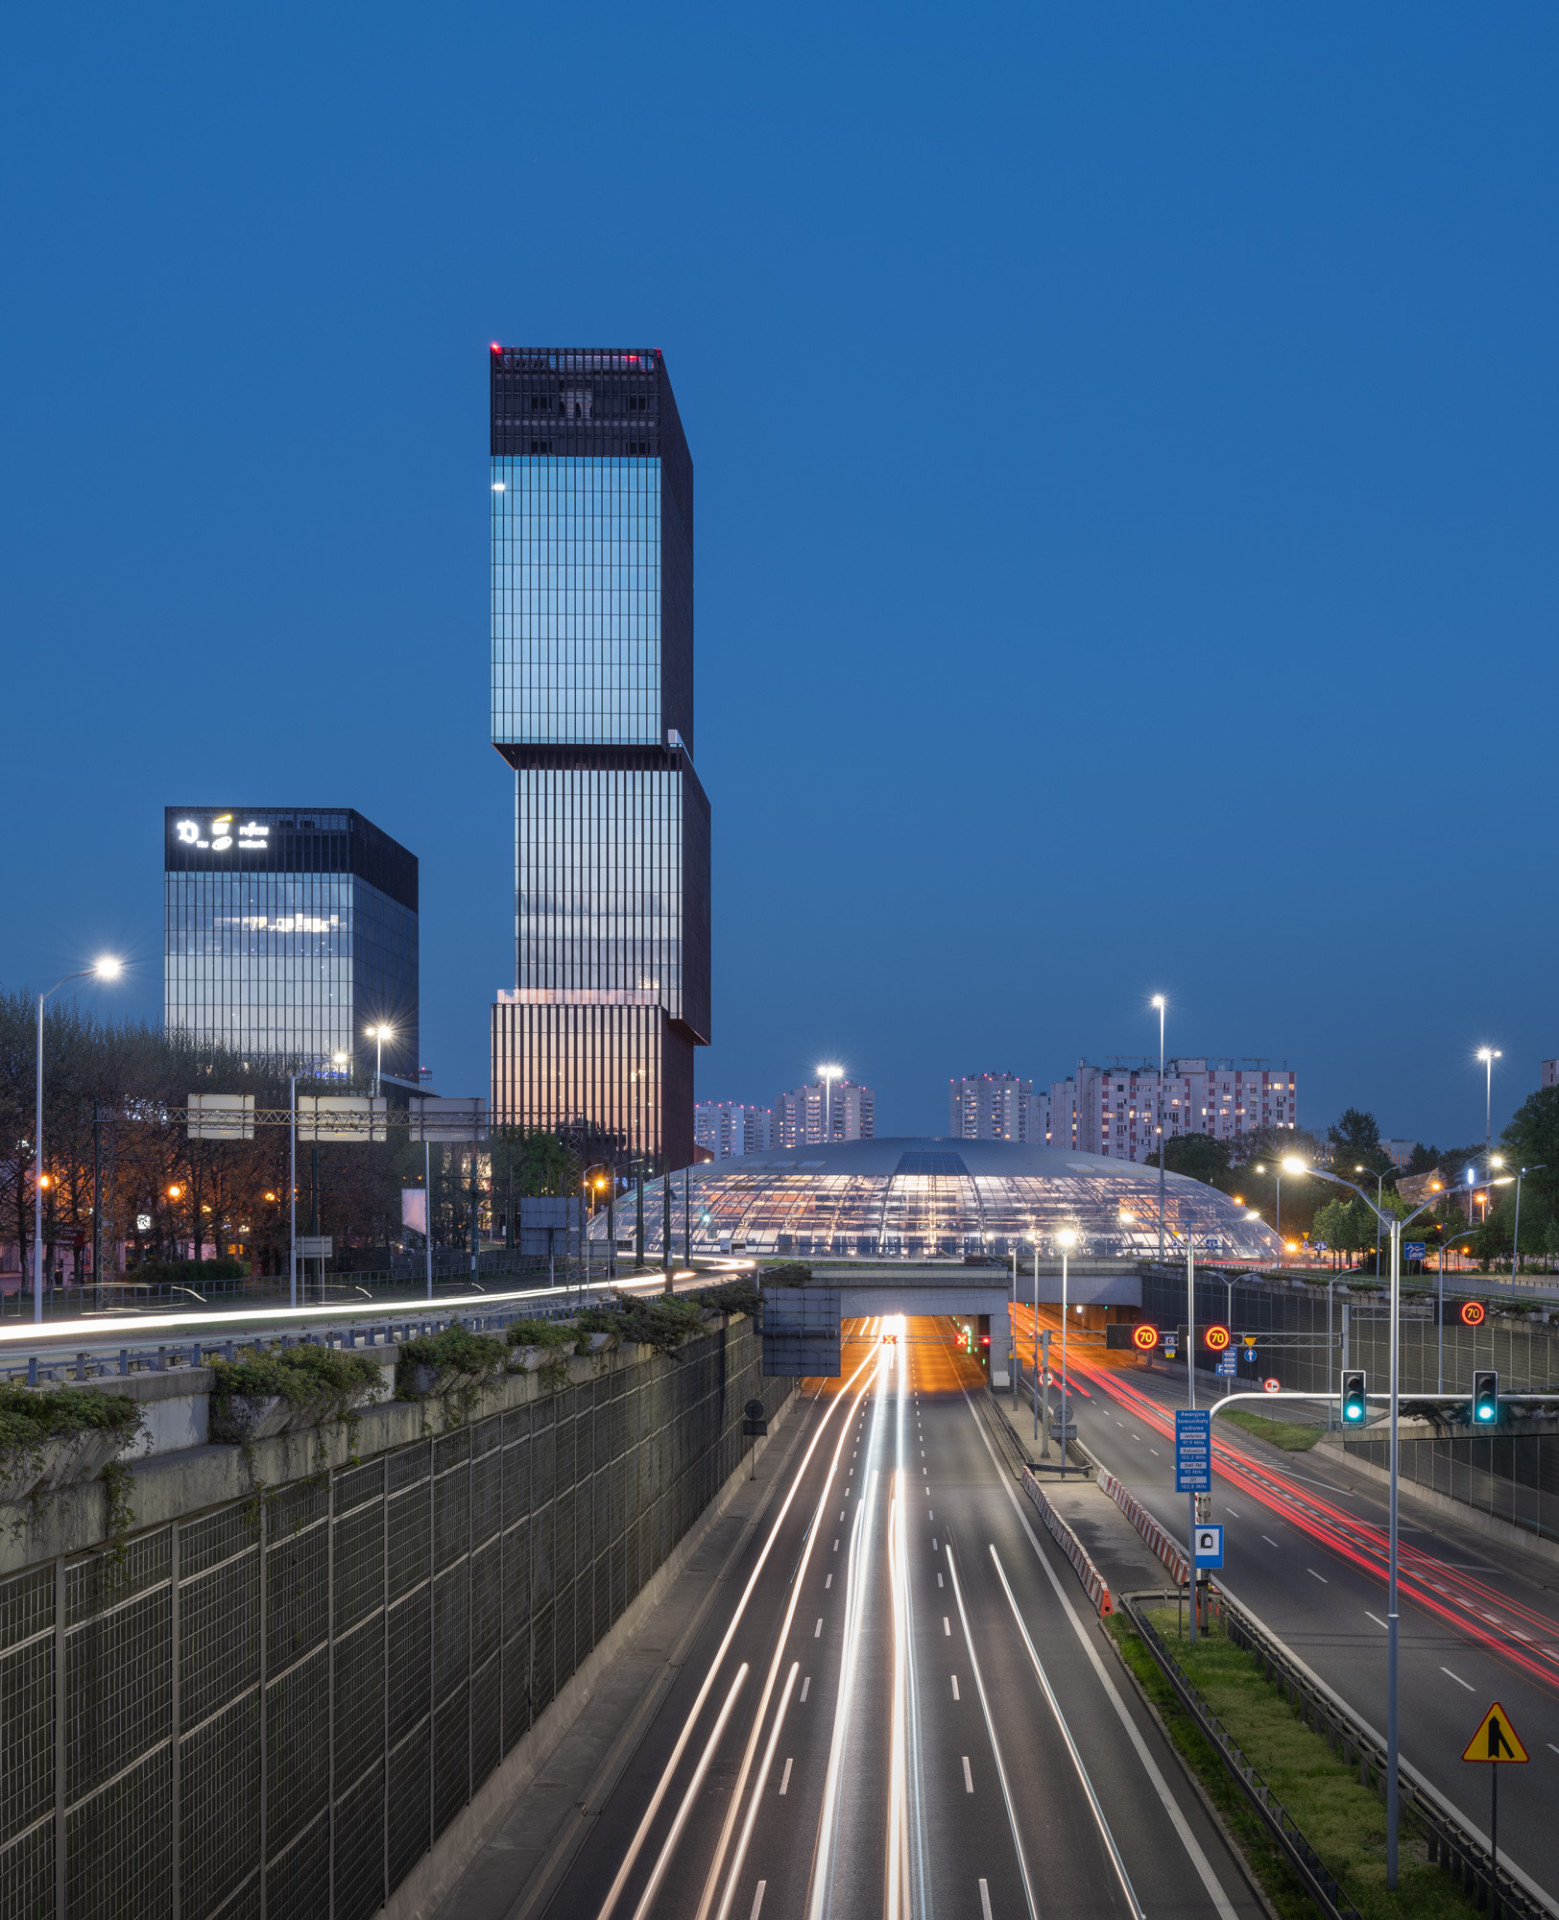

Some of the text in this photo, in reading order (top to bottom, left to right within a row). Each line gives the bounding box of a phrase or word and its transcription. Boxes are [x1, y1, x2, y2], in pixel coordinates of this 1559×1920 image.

[1467, 1308, 1480, 1319] 70
[1140, 1332, 1153, 1343] 70
[1211, 1333, 1225, 1344] 70
